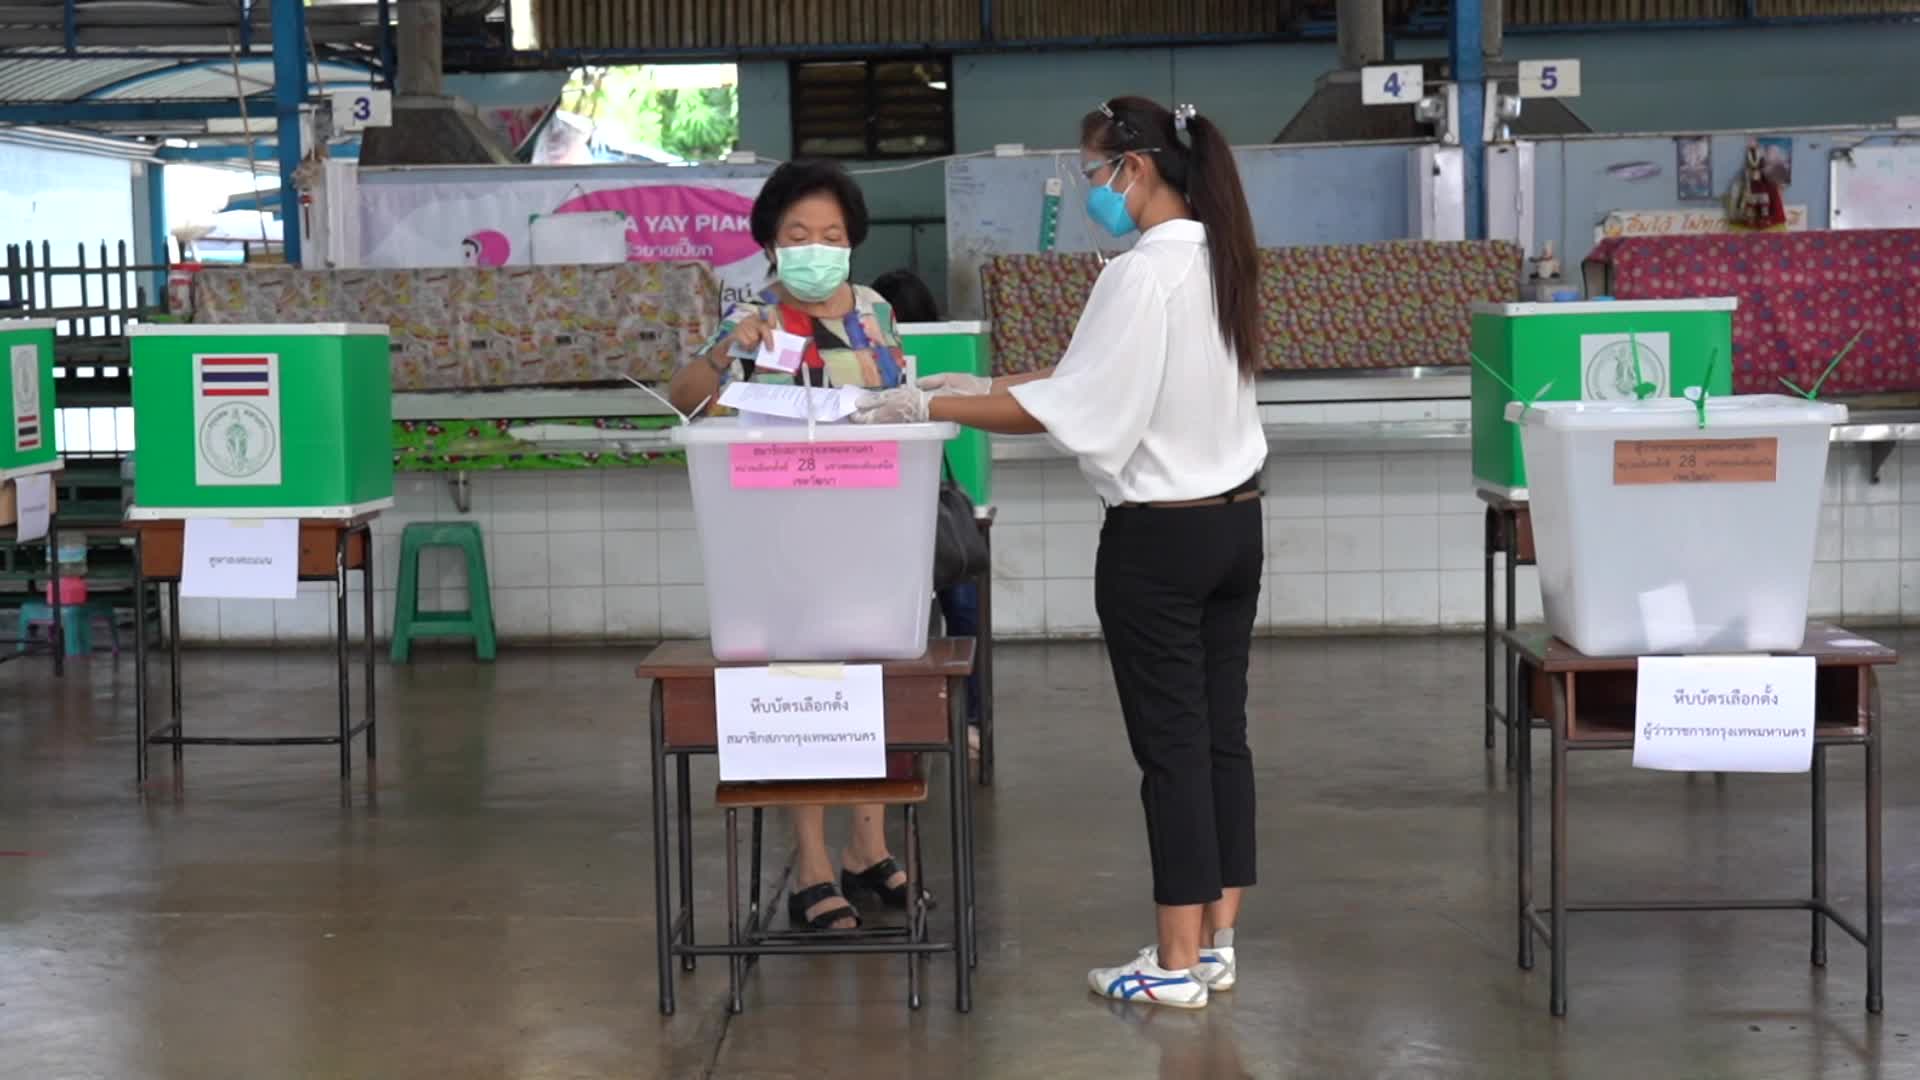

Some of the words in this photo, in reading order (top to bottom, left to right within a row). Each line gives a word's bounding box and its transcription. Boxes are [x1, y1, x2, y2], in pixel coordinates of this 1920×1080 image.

[1383, 72, 1401, 97] 4
[1540, 66, 1558, 91] 5
[353, 97, 371, 120] 3
[644, 214, 690, 233] YAY
[695, 214, 752, 233] PIAK
[798, 458, 816, 472] 28
[1679, 454, 1696, 468] 28
[750, 691, 850, 714] หีบบัตรเลือกตั้ง
[1673, 683, 1779, 706] หีบบัตรเลือกตั้ง
[726, 731, 877, 748] สมาชิกสภากรุงเทพมหานคร
[1642, 722, 1807, 741] ผู้ว่าราชการกรุงเทพมหานคร
